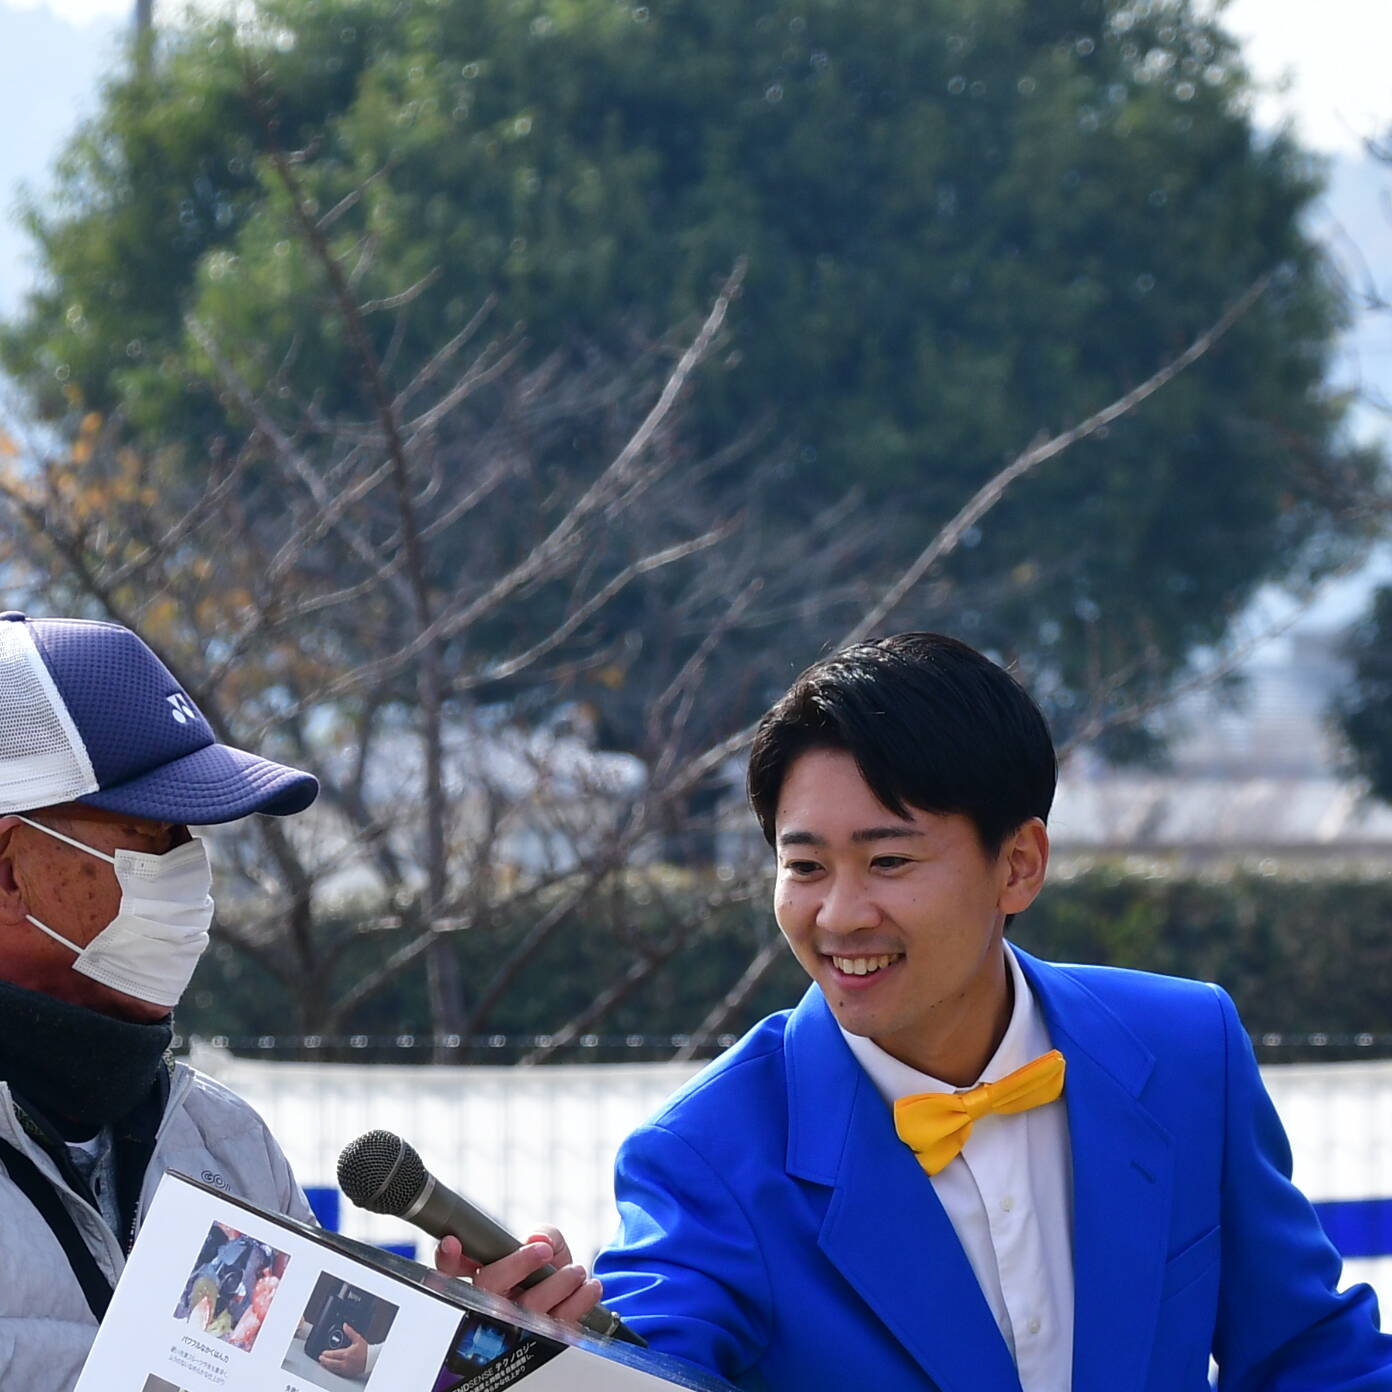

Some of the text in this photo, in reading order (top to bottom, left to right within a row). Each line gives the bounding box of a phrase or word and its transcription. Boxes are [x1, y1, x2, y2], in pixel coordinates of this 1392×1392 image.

[495, 1341, 537, 1370] テクノロジー
